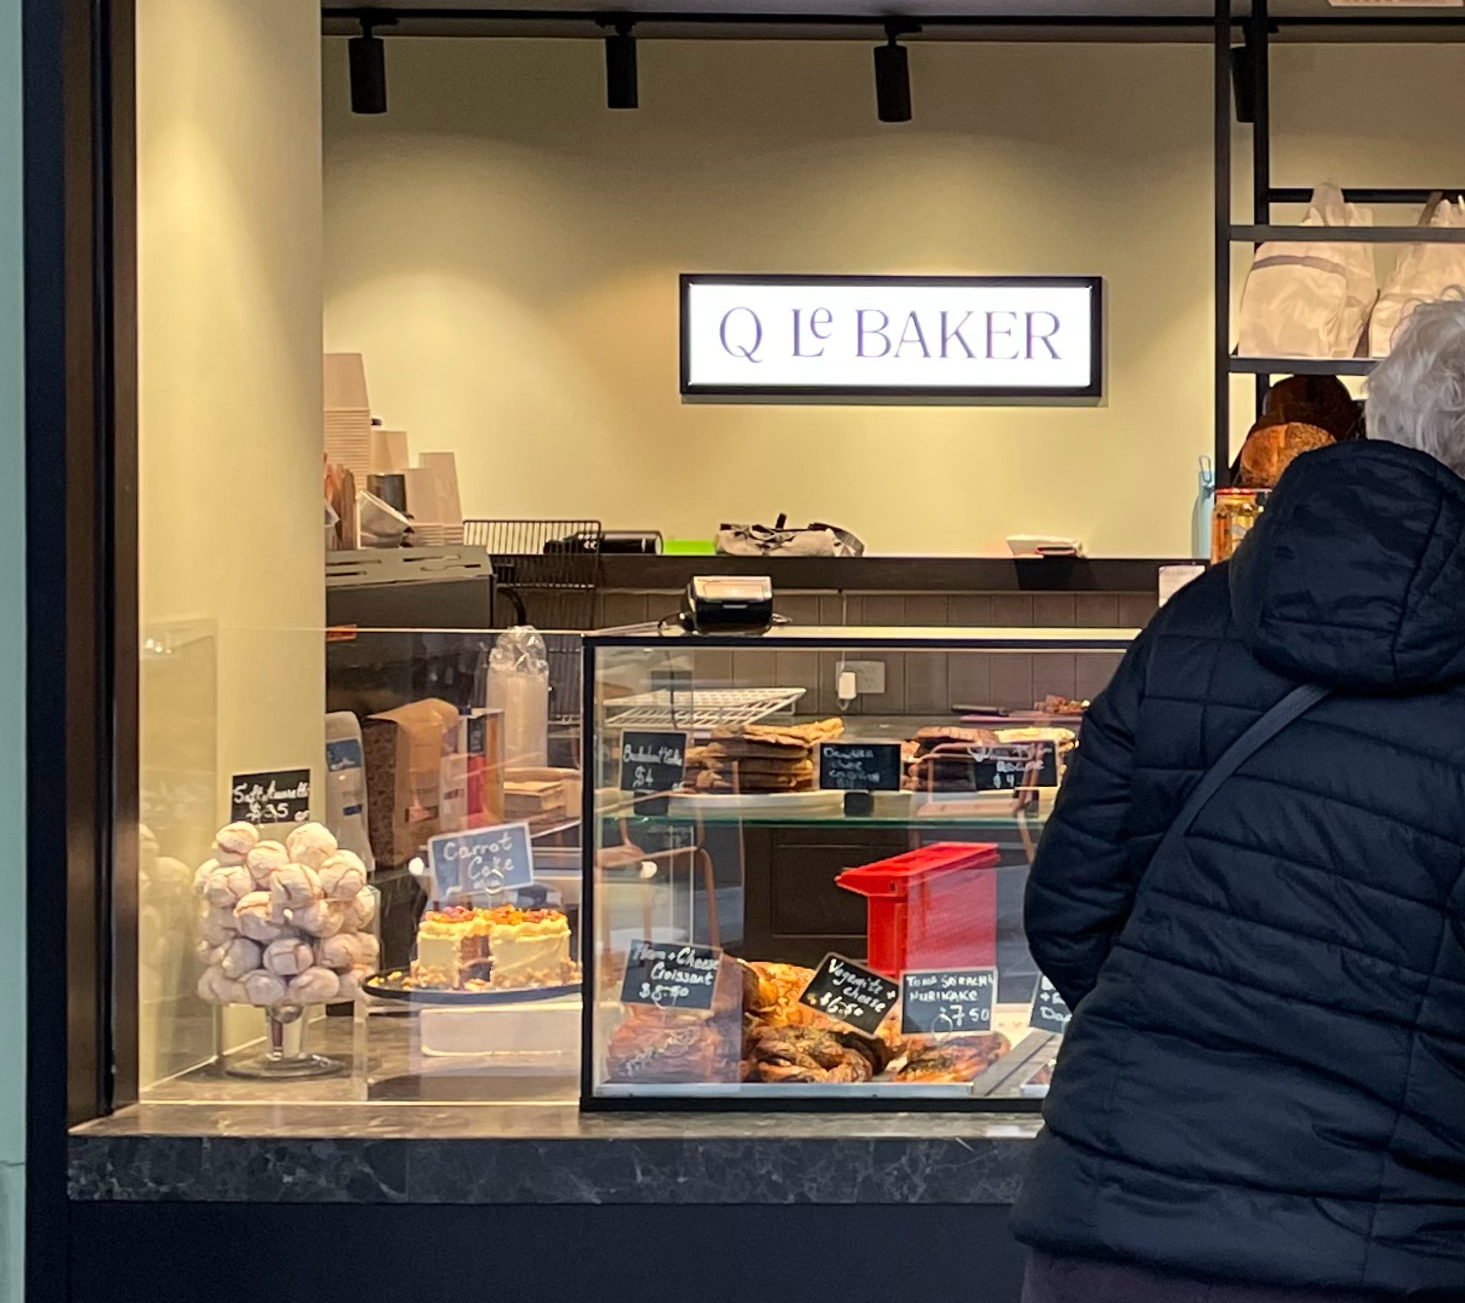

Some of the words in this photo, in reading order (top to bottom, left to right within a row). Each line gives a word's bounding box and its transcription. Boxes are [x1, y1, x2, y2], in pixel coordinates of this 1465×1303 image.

[719, 306, 763, 363] Q
[791, 306, 834, 358] Le
[854, 308, 1062, 360] BAKER
[443, 831, 513, 860] Carrot
[468, 856, 514, 880] Cake
[650, 961, 714, 985] Croissant
[828, 958, 883, 995] Vegemite
